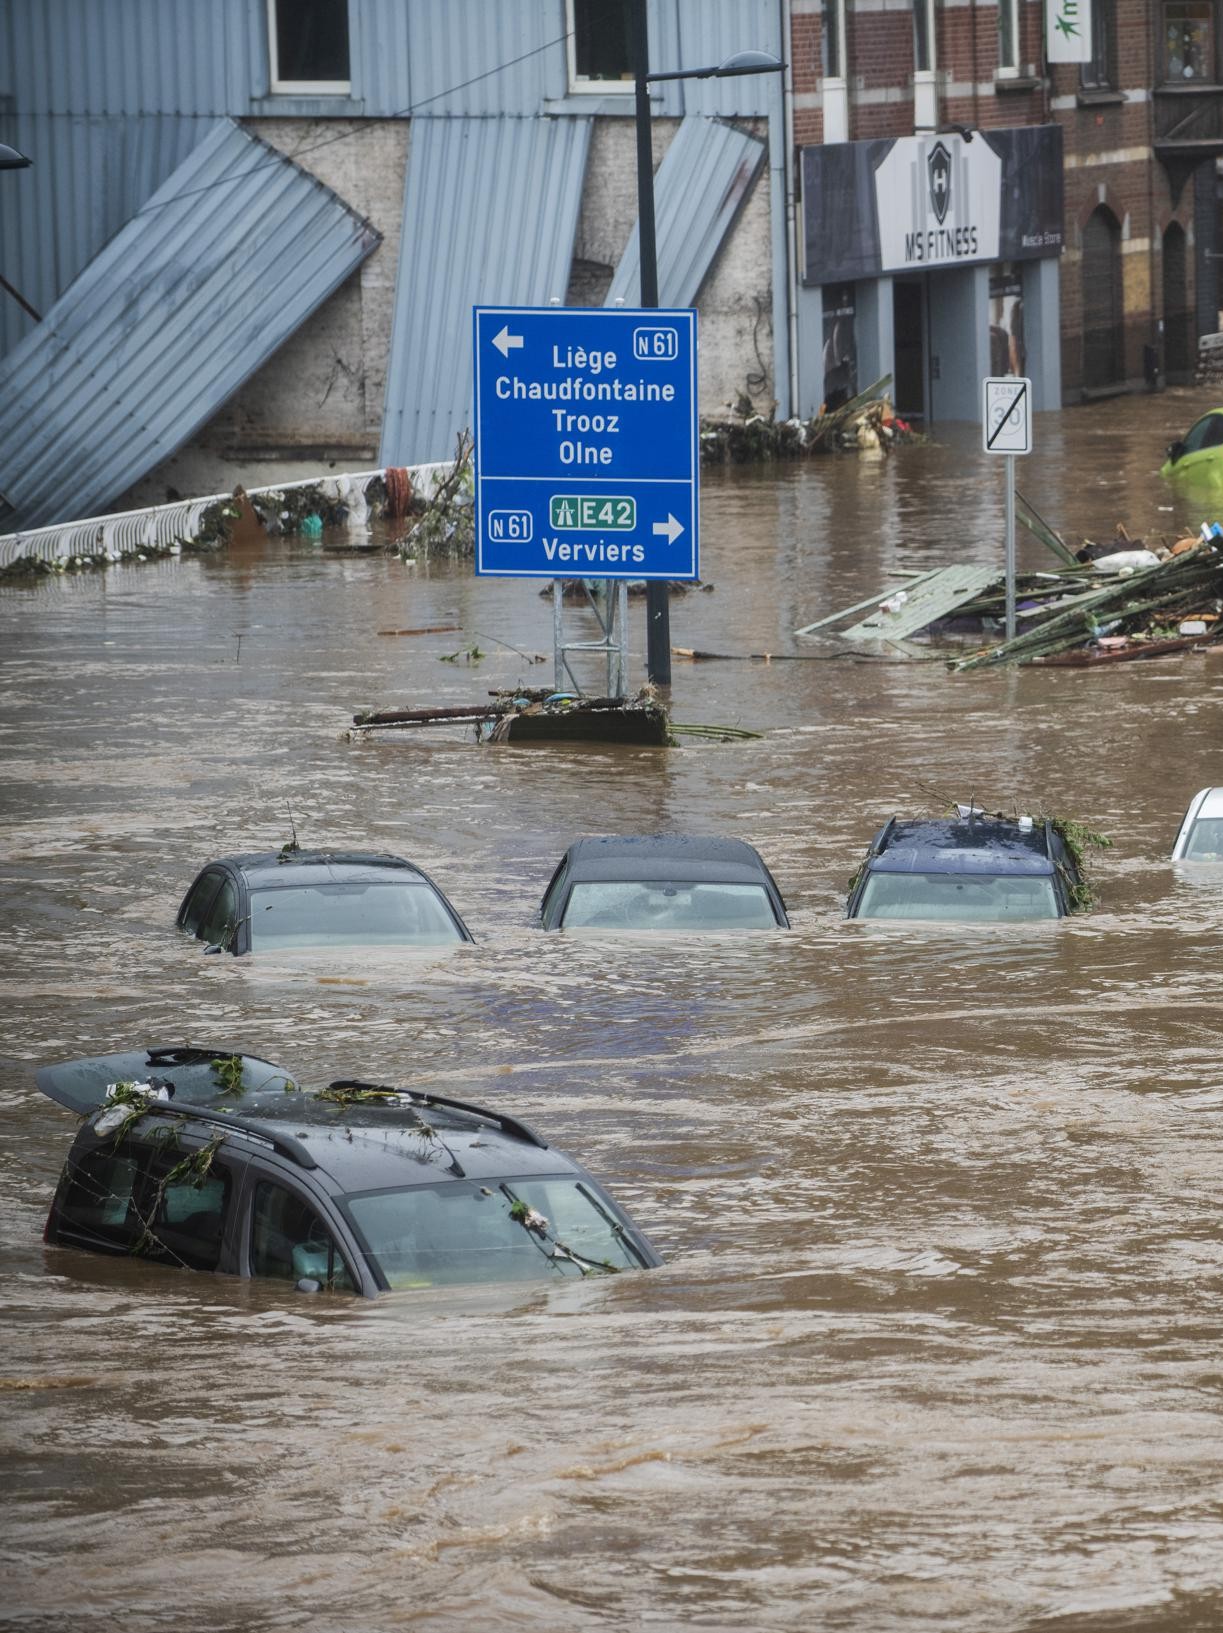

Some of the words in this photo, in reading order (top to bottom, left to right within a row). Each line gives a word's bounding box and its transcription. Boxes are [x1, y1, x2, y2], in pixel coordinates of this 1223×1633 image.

[905, 233, 923, 262] MS
[928, 226, 977, 257] FITNESS
[638, 336, 649, 355] N
[653, 332, 673, 356] 61
[552, 345, 617, 374] Liège
[495, 376, 675, 402] Chaudfontaine
[994, 386, 1019, 395] ZONE
[552, 409, 619, 432] Trooz
[994, 407, 1020, 425] 30
[559, 441, 613, 465] Olne
[583, 501, 632, 525] E42
[493, 519, 504, 538] N
[508, 515, 528, 538] 61
[542, 538, 645, 562] Verviers
